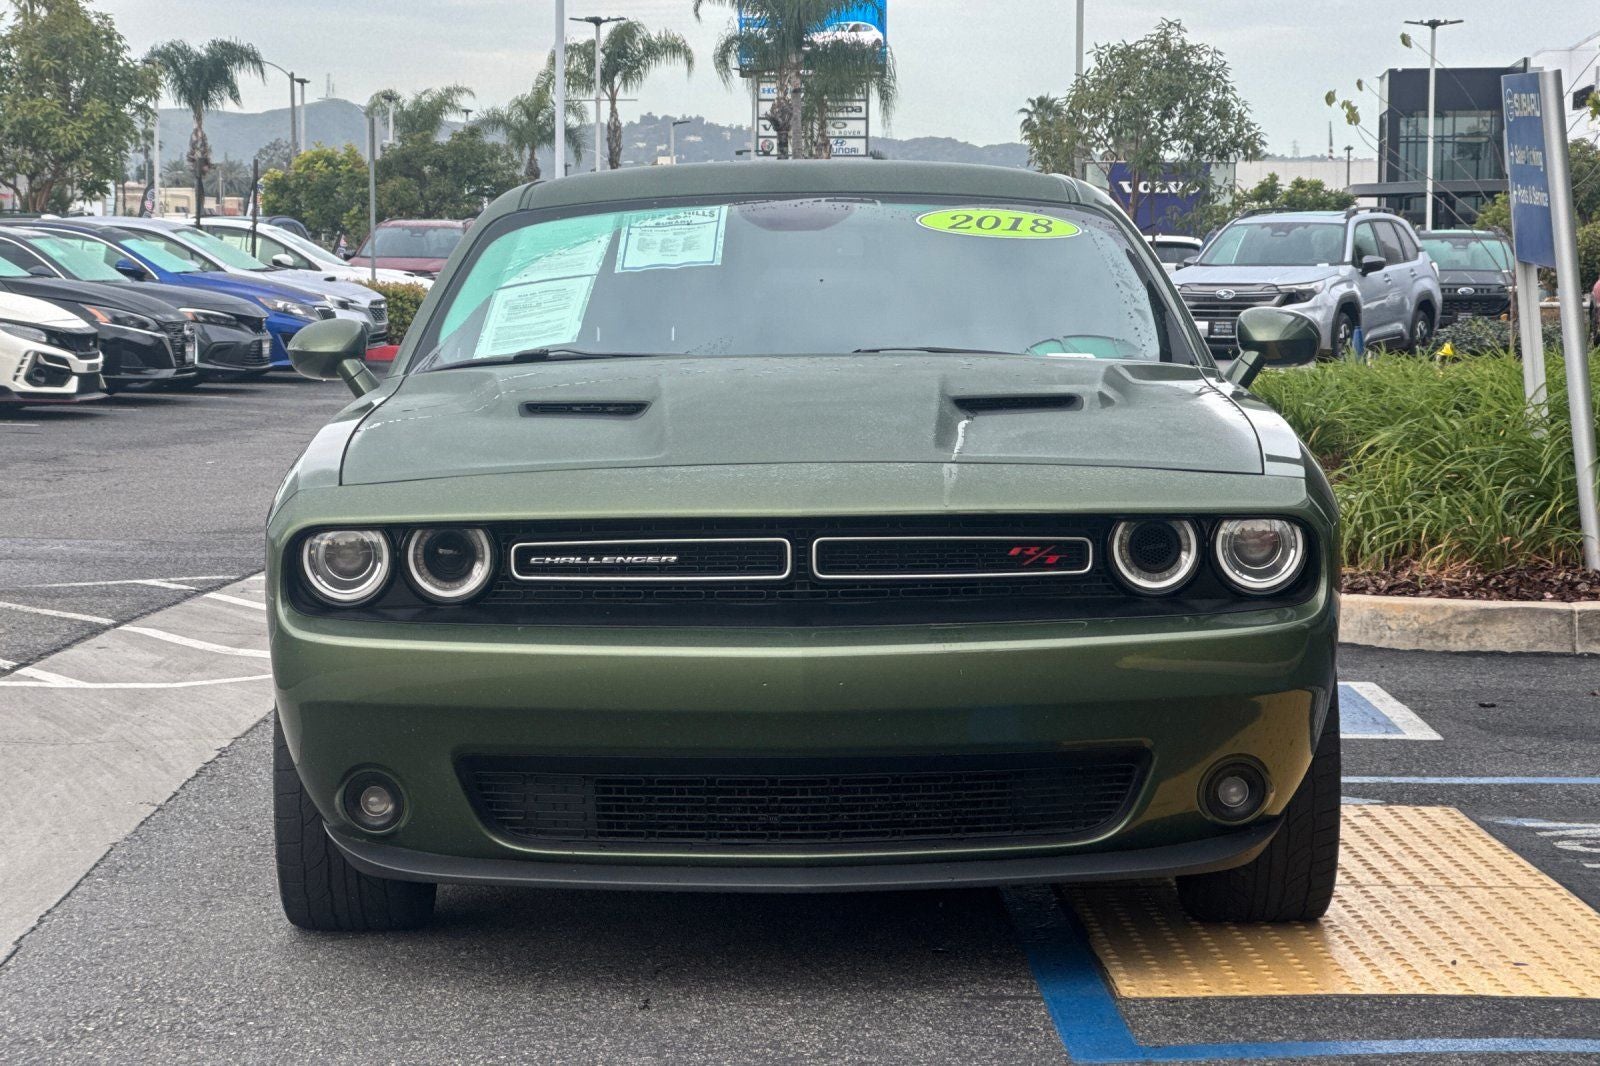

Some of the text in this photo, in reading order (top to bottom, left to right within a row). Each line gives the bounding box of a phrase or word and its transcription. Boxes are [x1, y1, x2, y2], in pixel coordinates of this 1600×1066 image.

[1513, 93, 1541, 117] SUBARU
[947, 214, 1054, 234] 2018
[529, 555, 678, 564] CHALLENGER
